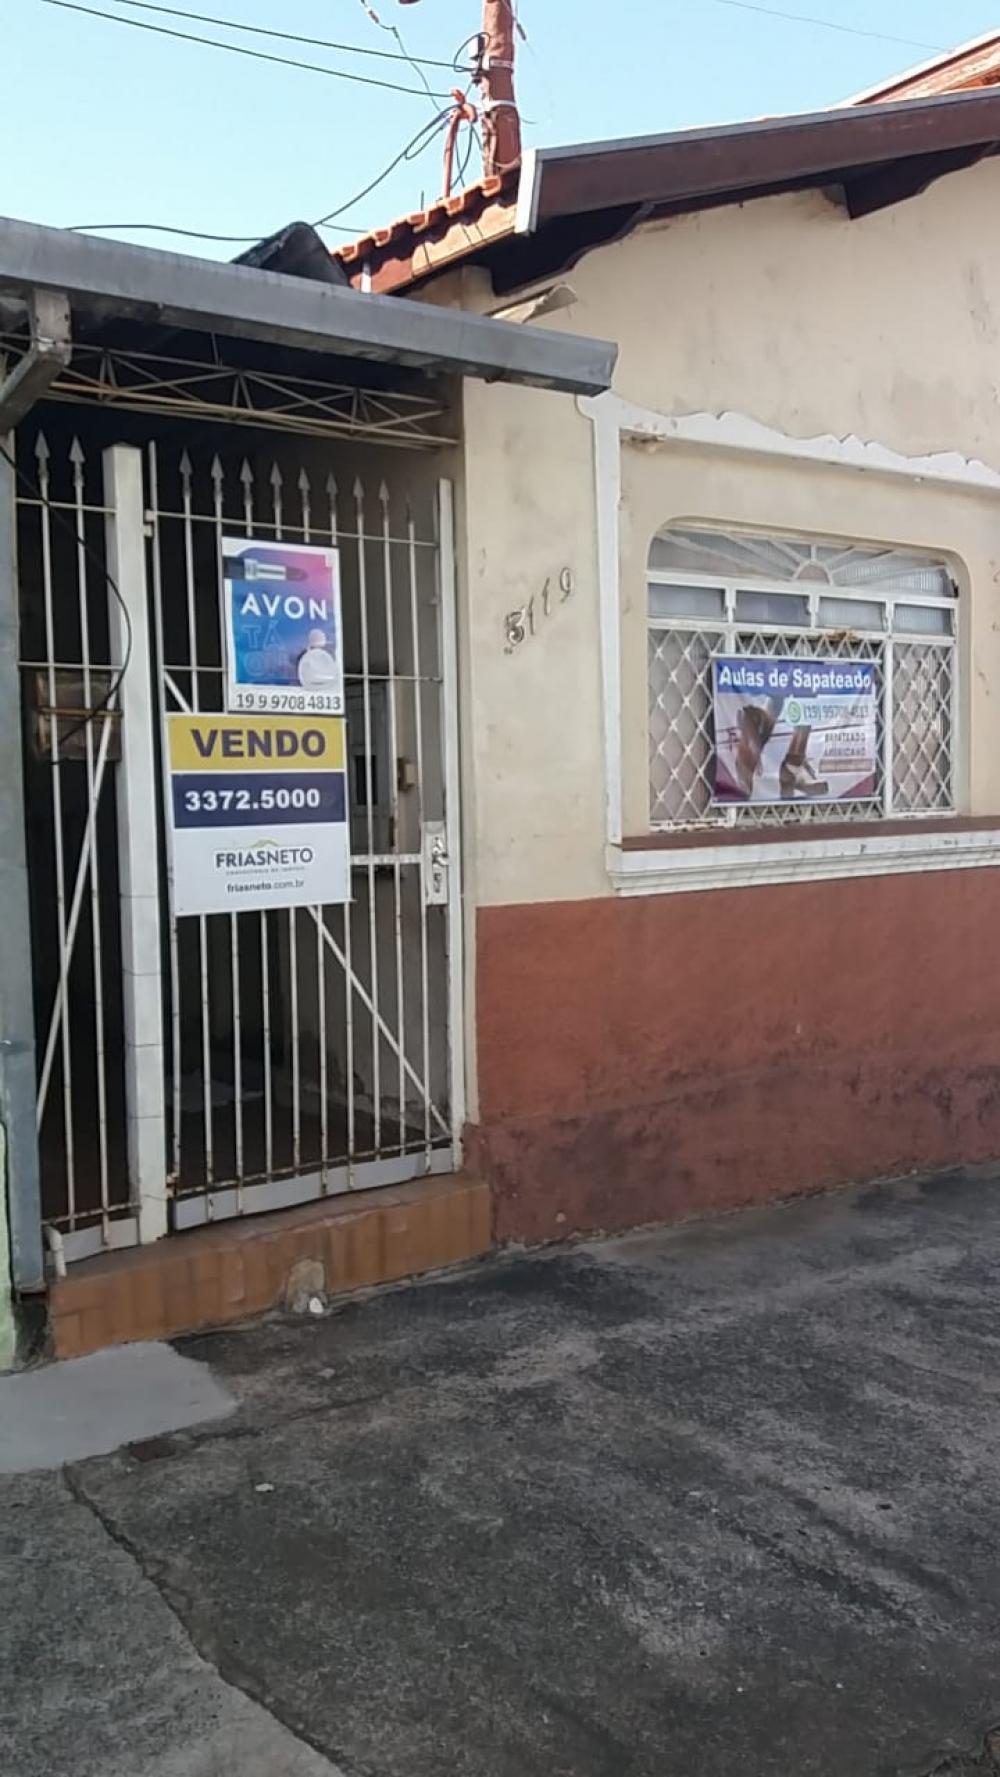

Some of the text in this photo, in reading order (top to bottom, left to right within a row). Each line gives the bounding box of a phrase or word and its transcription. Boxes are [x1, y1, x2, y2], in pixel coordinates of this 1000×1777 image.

[241, 593, 328, 621] AVON
[719, 666, 872, 693] Aulas de Sapateado
[237, 693, 341, 710] 19 9 9708 4813
[191, 728, 326, 758] VENDO
[185, 788, 320, 812] 3372.5000
[216, 848, 313, 868] FRIASNETO
